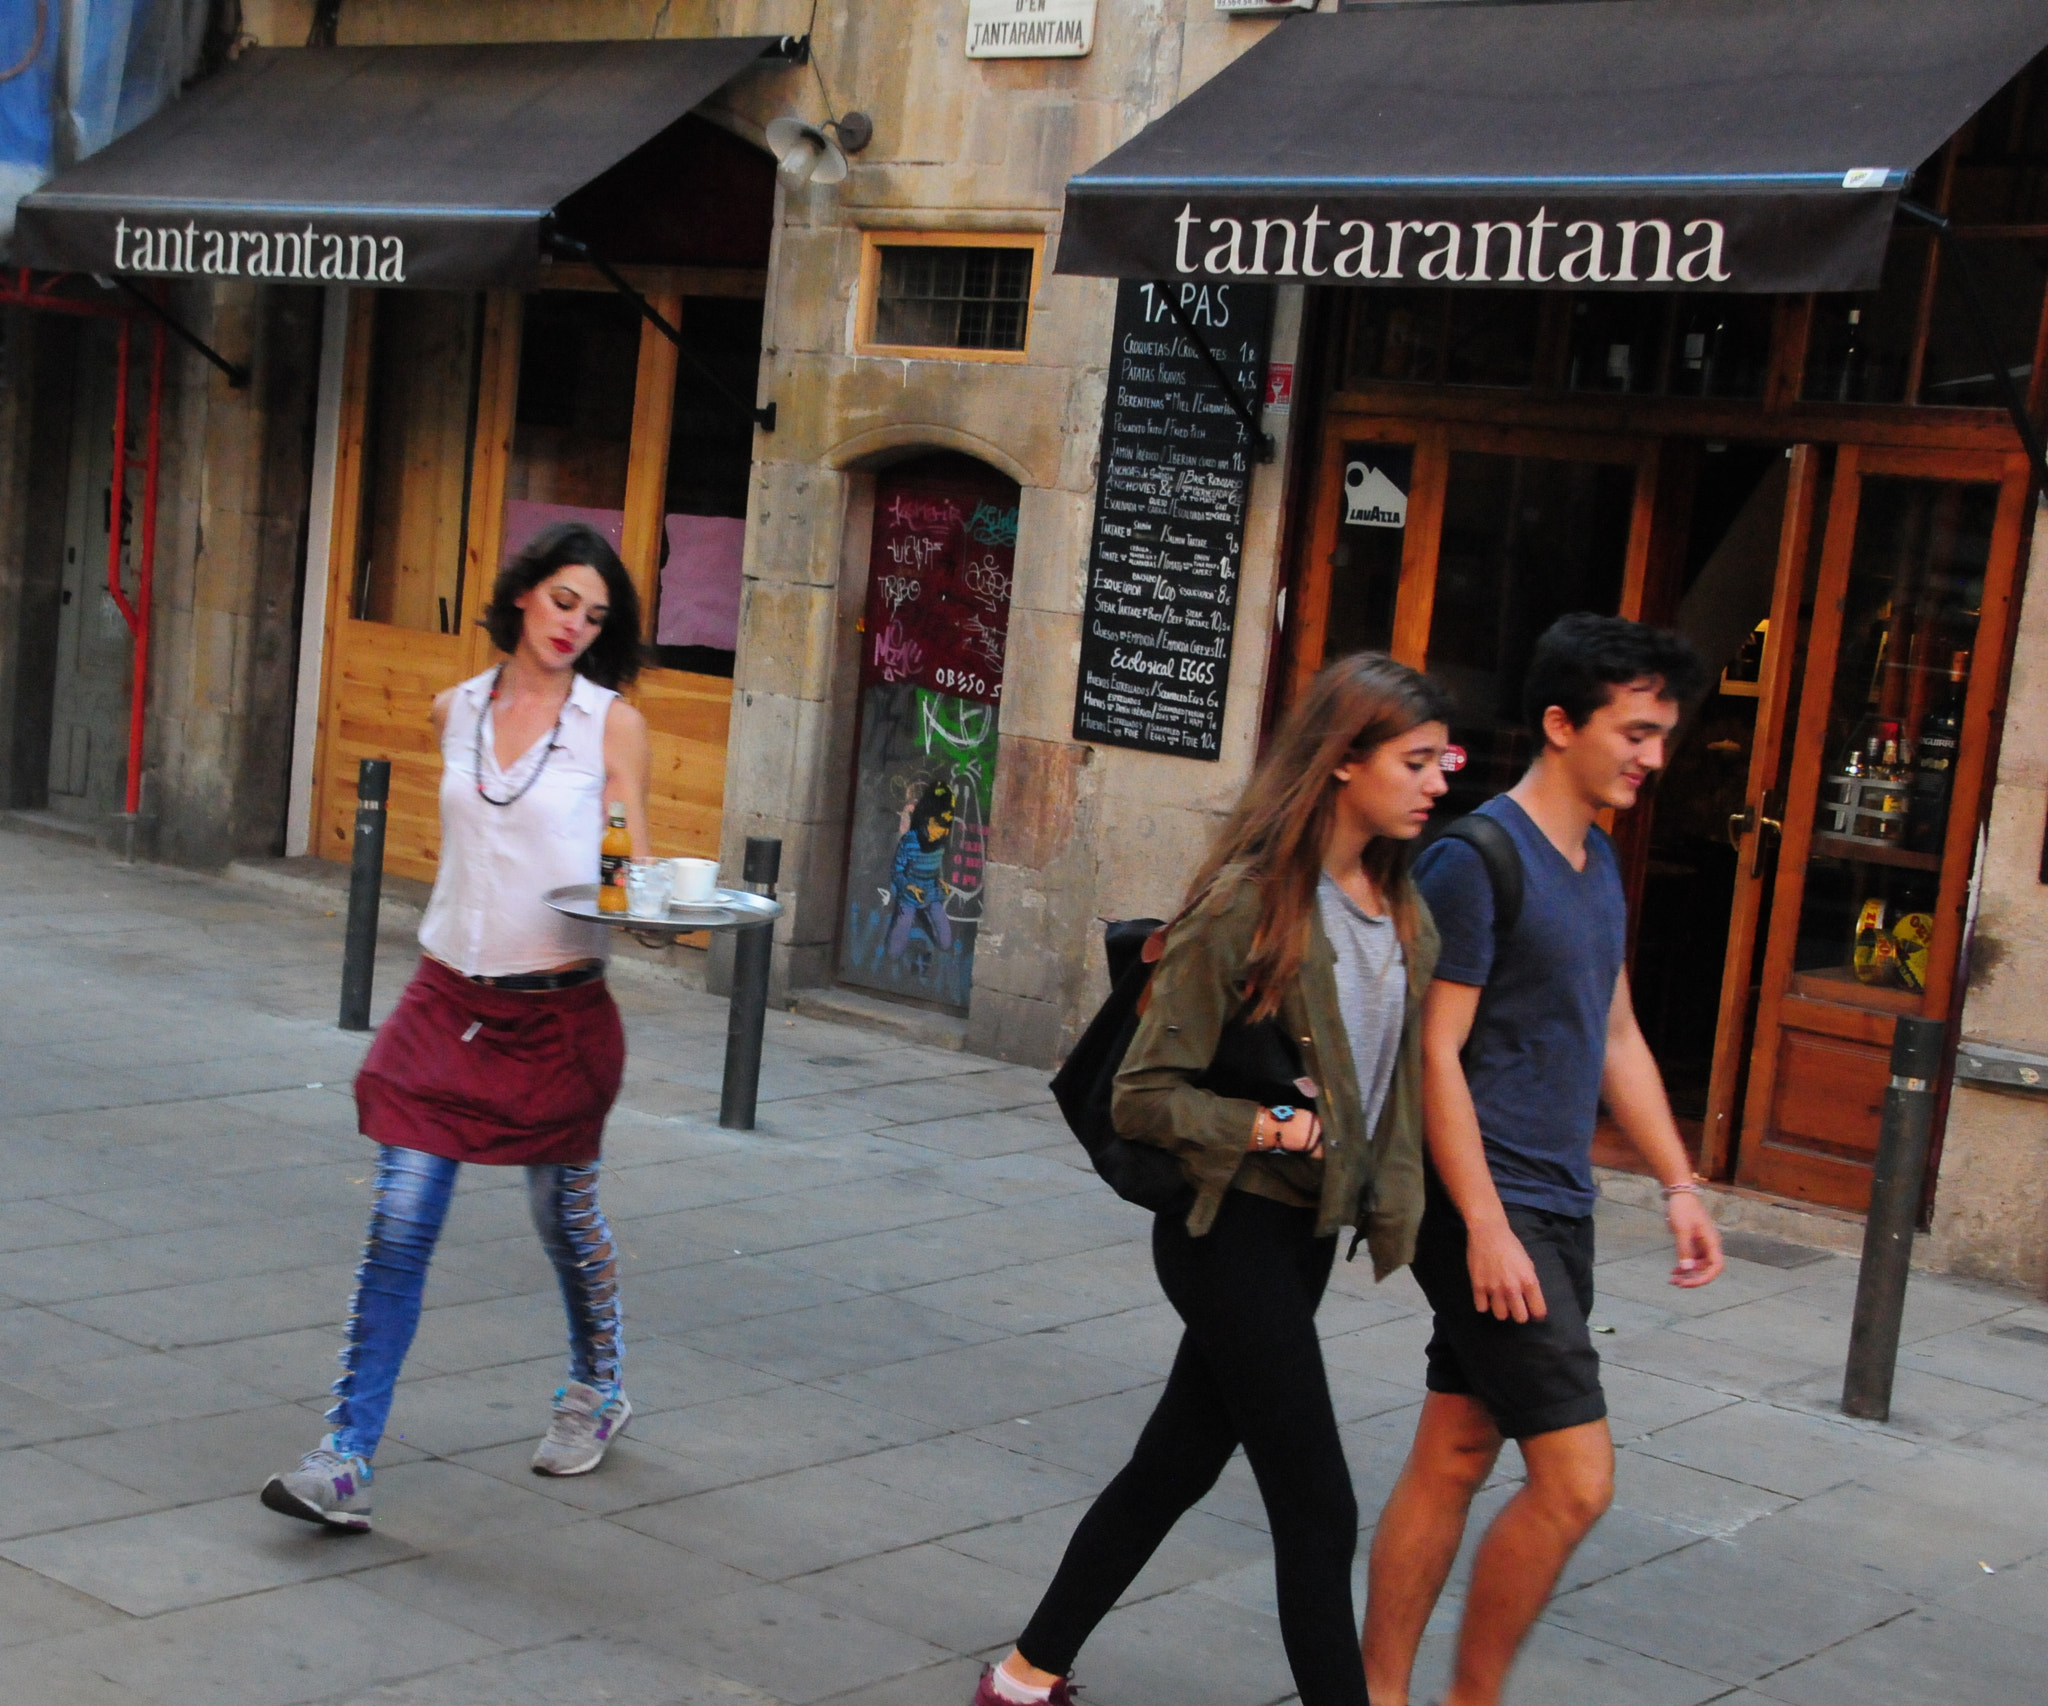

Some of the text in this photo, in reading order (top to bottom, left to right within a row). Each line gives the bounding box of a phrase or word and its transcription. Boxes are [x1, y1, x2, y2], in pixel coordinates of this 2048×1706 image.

[973, 20, 1084, 46] TANTARANTANA
[114, 216, 407, 283] tantarantana
[1174, 202, 1731, 283] tantarantana
[1121, 358, 1155, 383] PATATAS
[1350, 506, 1400, 523] LAVAZZA
[1110, 647, 1215, 685] Ecological EGGS
